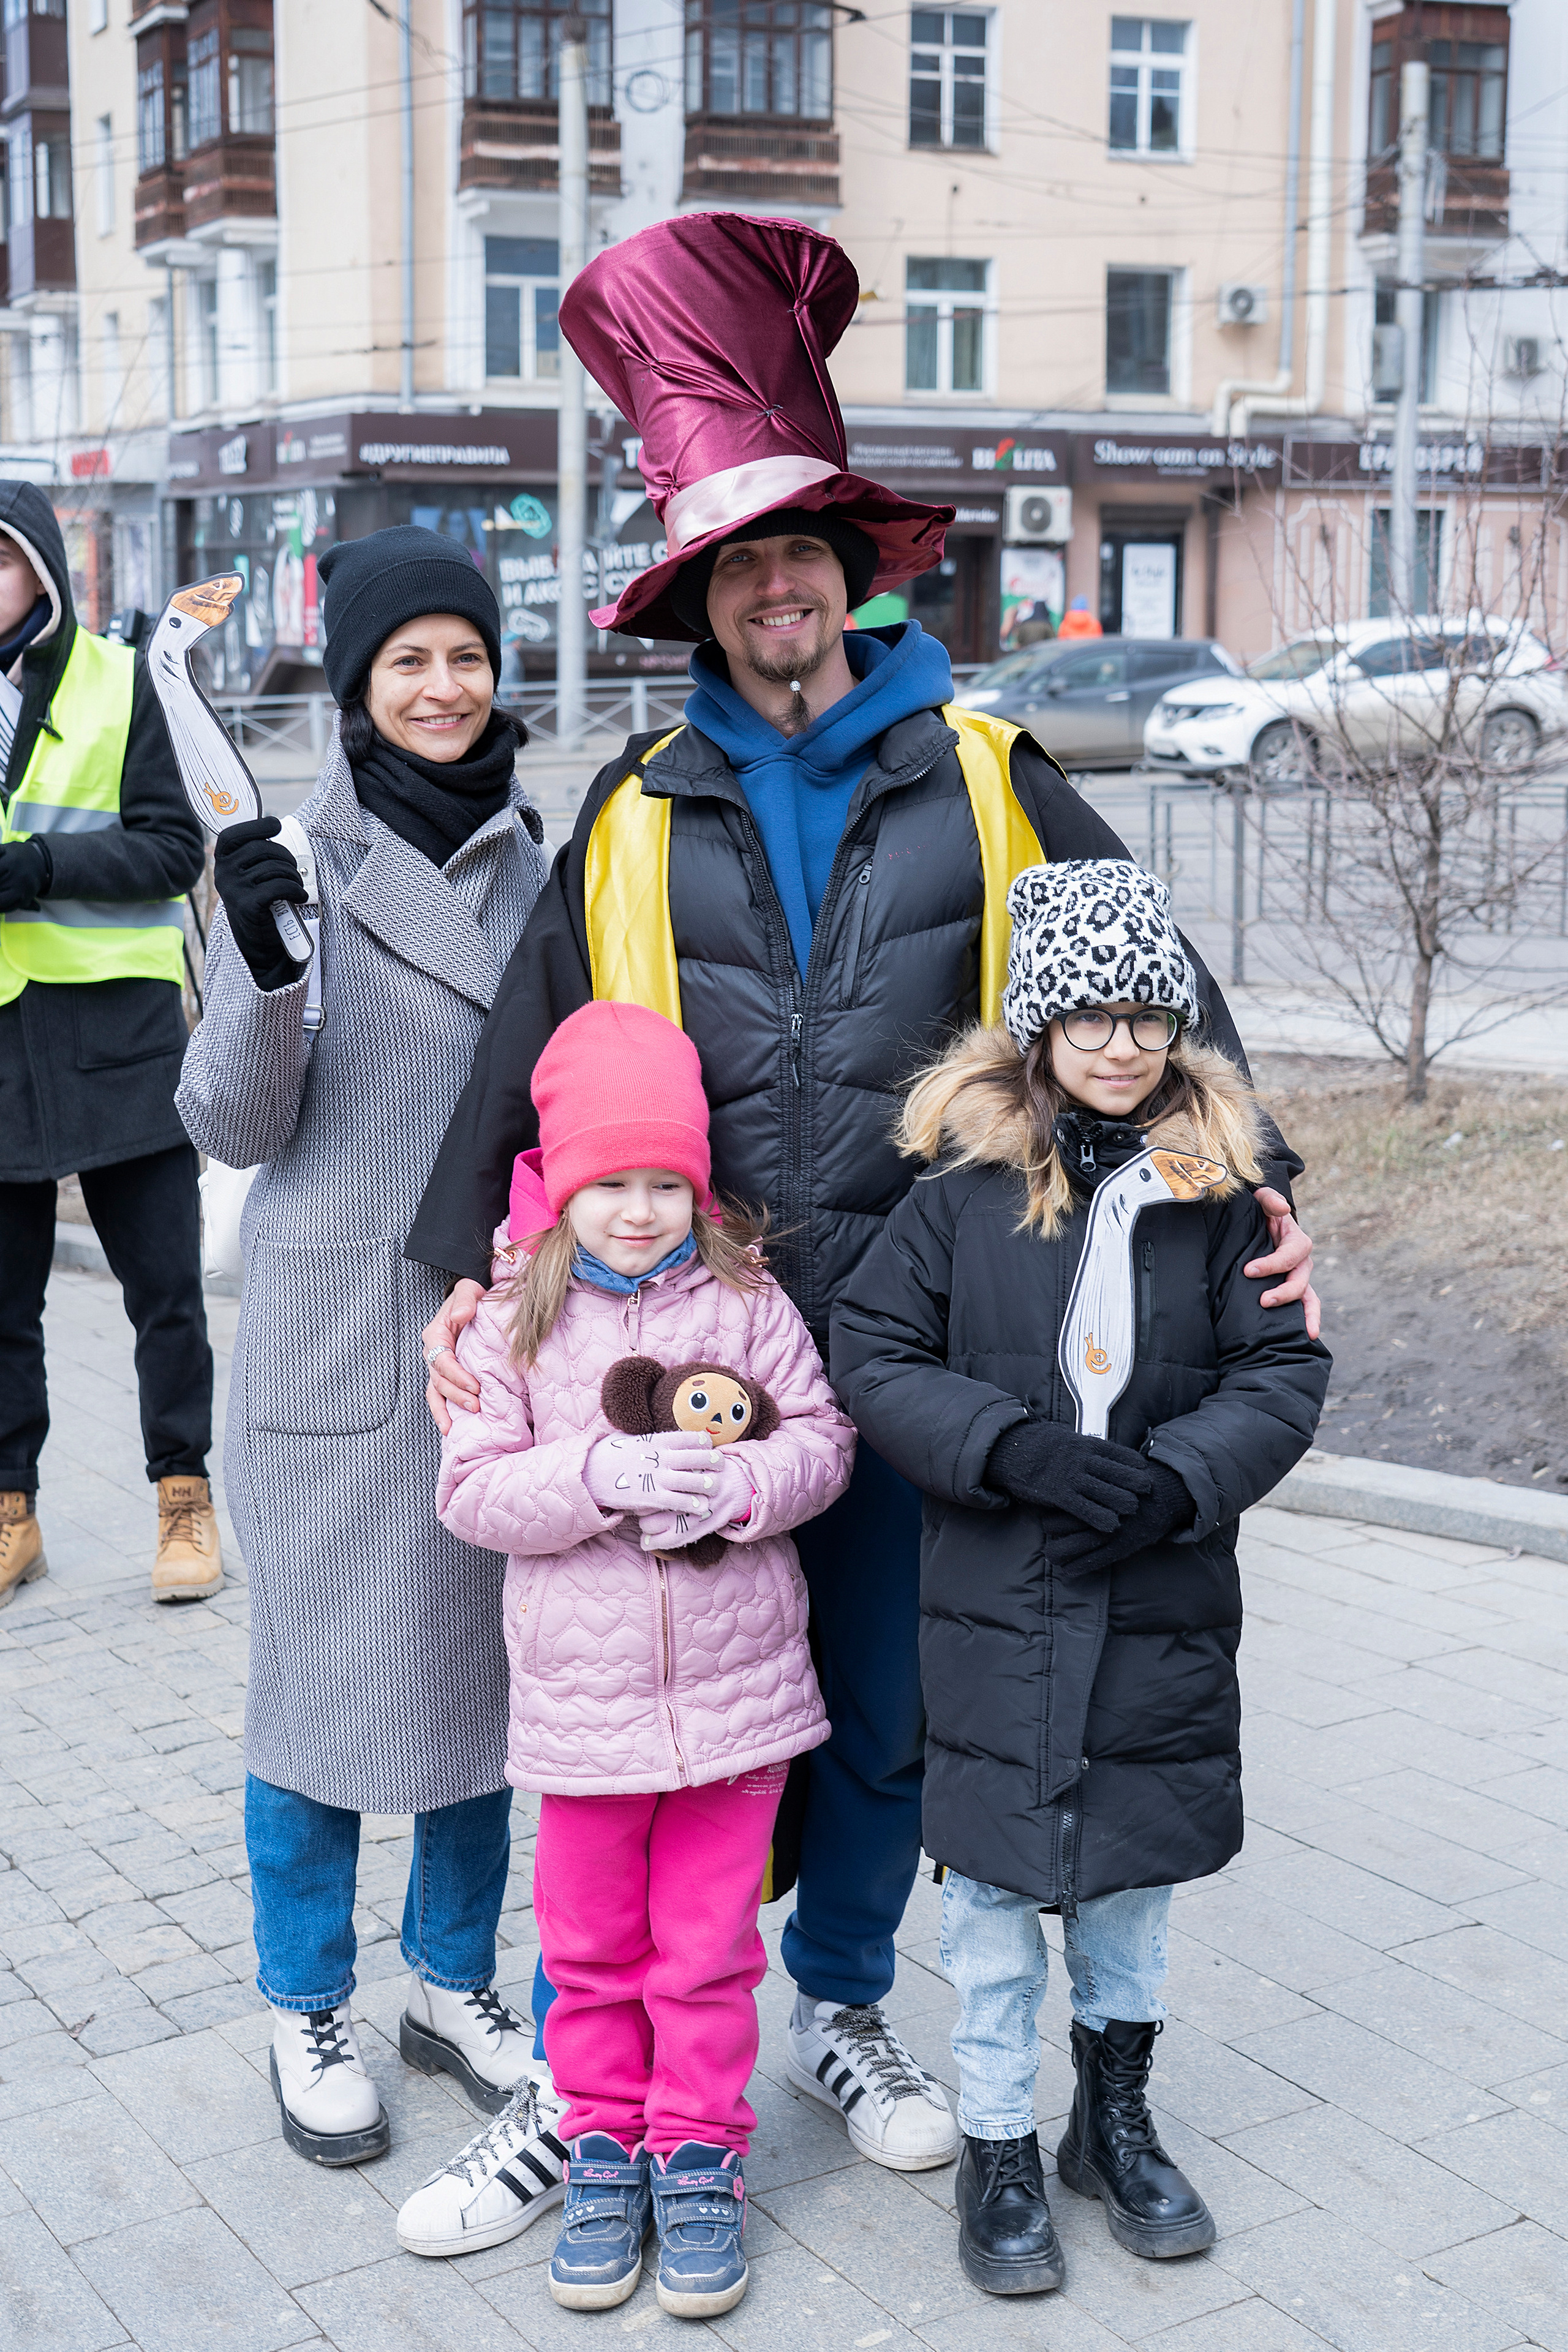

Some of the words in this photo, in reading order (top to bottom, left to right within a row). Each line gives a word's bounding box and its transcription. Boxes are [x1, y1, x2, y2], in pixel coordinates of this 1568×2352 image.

[1197, 448, 1225, 467] on
[272, 899, 289, 918] ВОС
[283, 919, 301, 940] ЕСТЬ
[172, 1486, 191, 1496] HH
